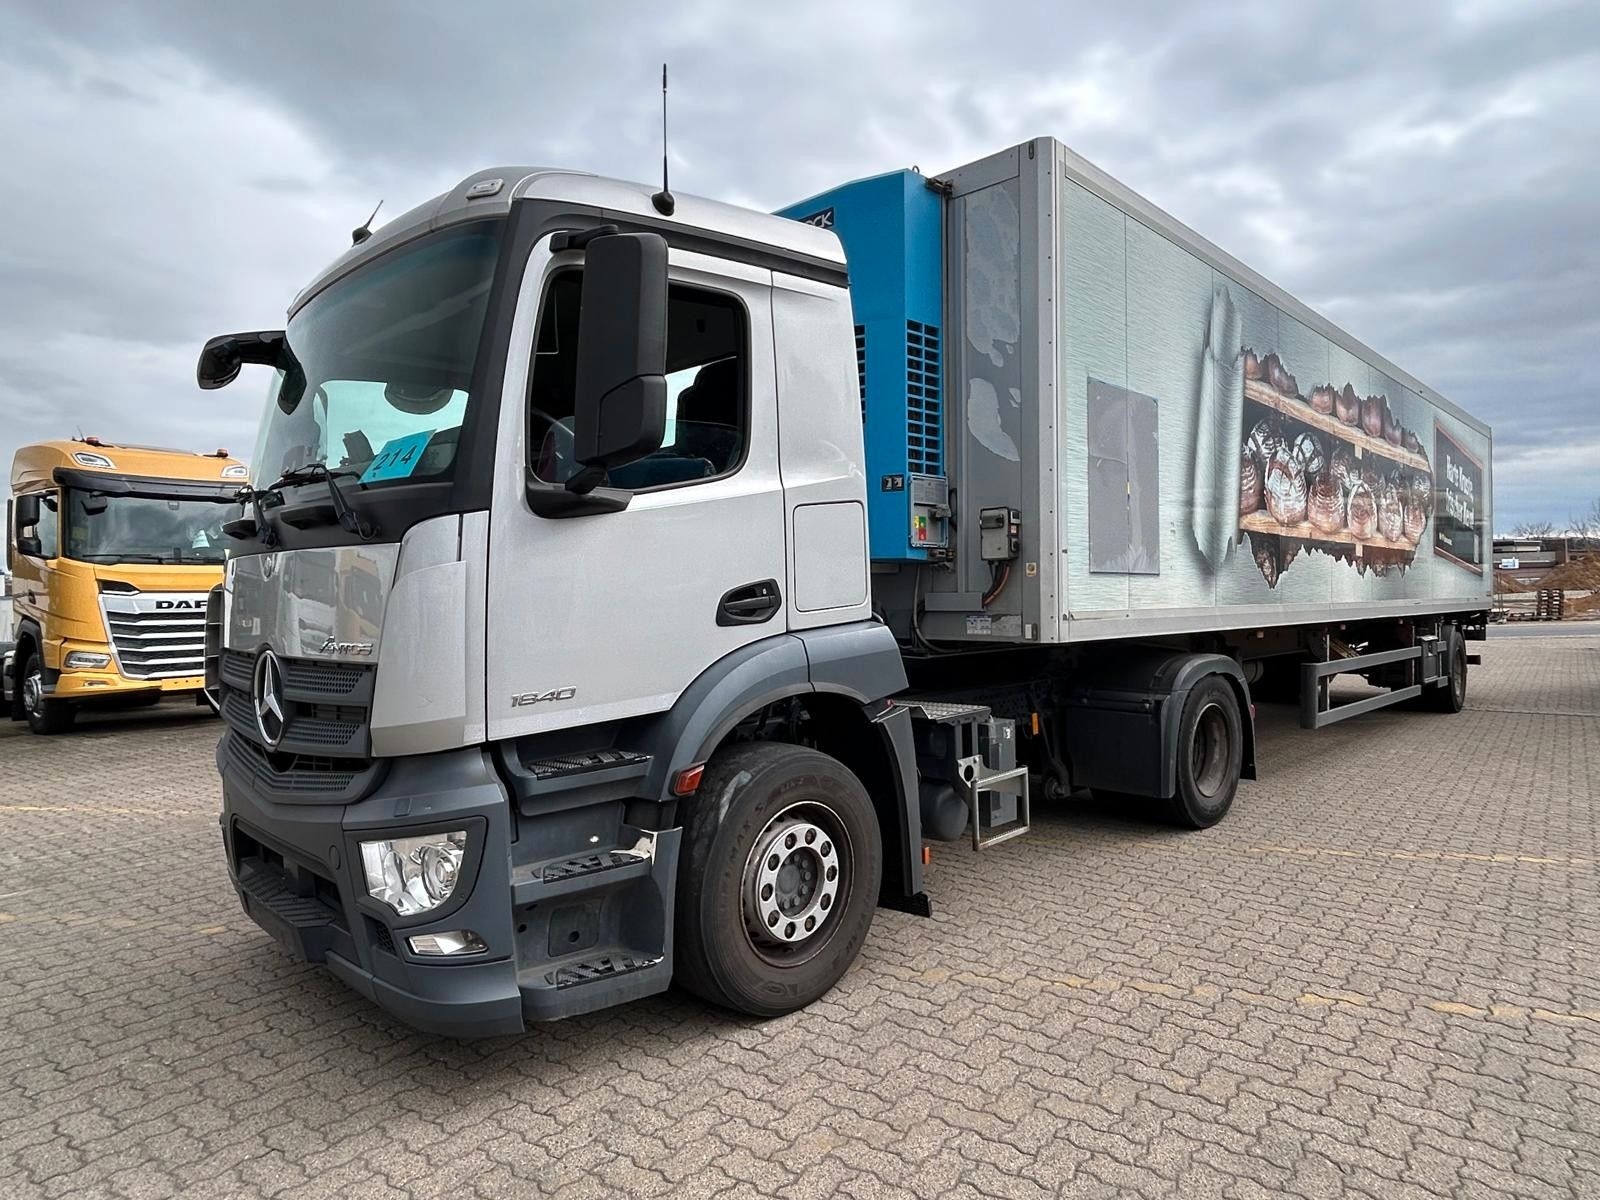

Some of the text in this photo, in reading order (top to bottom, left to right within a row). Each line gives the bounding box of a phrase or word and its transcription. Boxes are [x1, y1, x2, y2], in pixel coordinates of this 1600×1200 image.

[373, 445, 417, 471] 214
[156, 600, 207, 609] DAF
[511, 685, 576, 707] 1840
